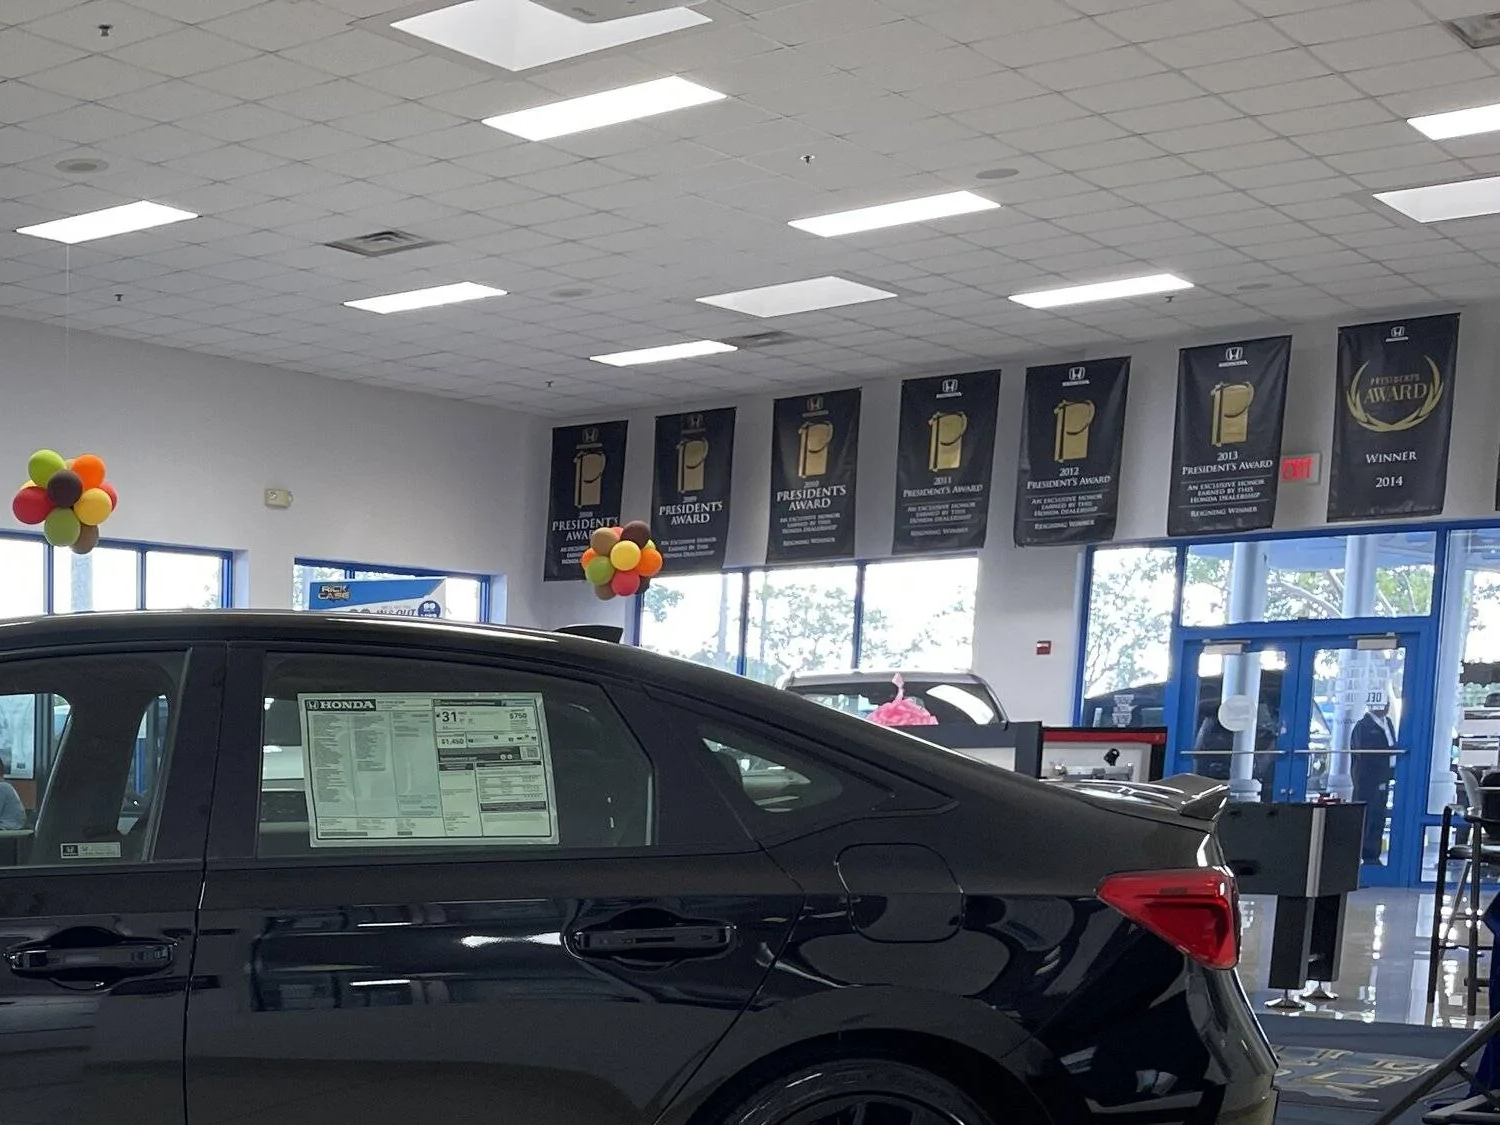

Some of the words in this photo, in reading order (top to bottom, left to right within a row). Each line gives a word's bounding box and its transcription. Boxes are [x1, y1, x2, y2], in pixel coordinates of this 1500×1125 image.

[1364, 383, 1427, 403] AWARD
[1217, 451, 1238, 461] 2013
[1366, 451, 1417, 464] WINNER
[1239, 460, 1273, 470] AWARD
[1059, 466, 1079, 477] 2012
[1079, 475, 1111, 486] AWARD
[1375, 475, 1403, 488] 2014
[952, 484, 983, 494] AWARD
[788, 497, 831, 511] AWARD
[671, 513, 710, 526] AWARD
[566, 529, 594, 542] AWA
[320, 700, 375, 709] HONDA
[442, 711, 457, 722] 31
